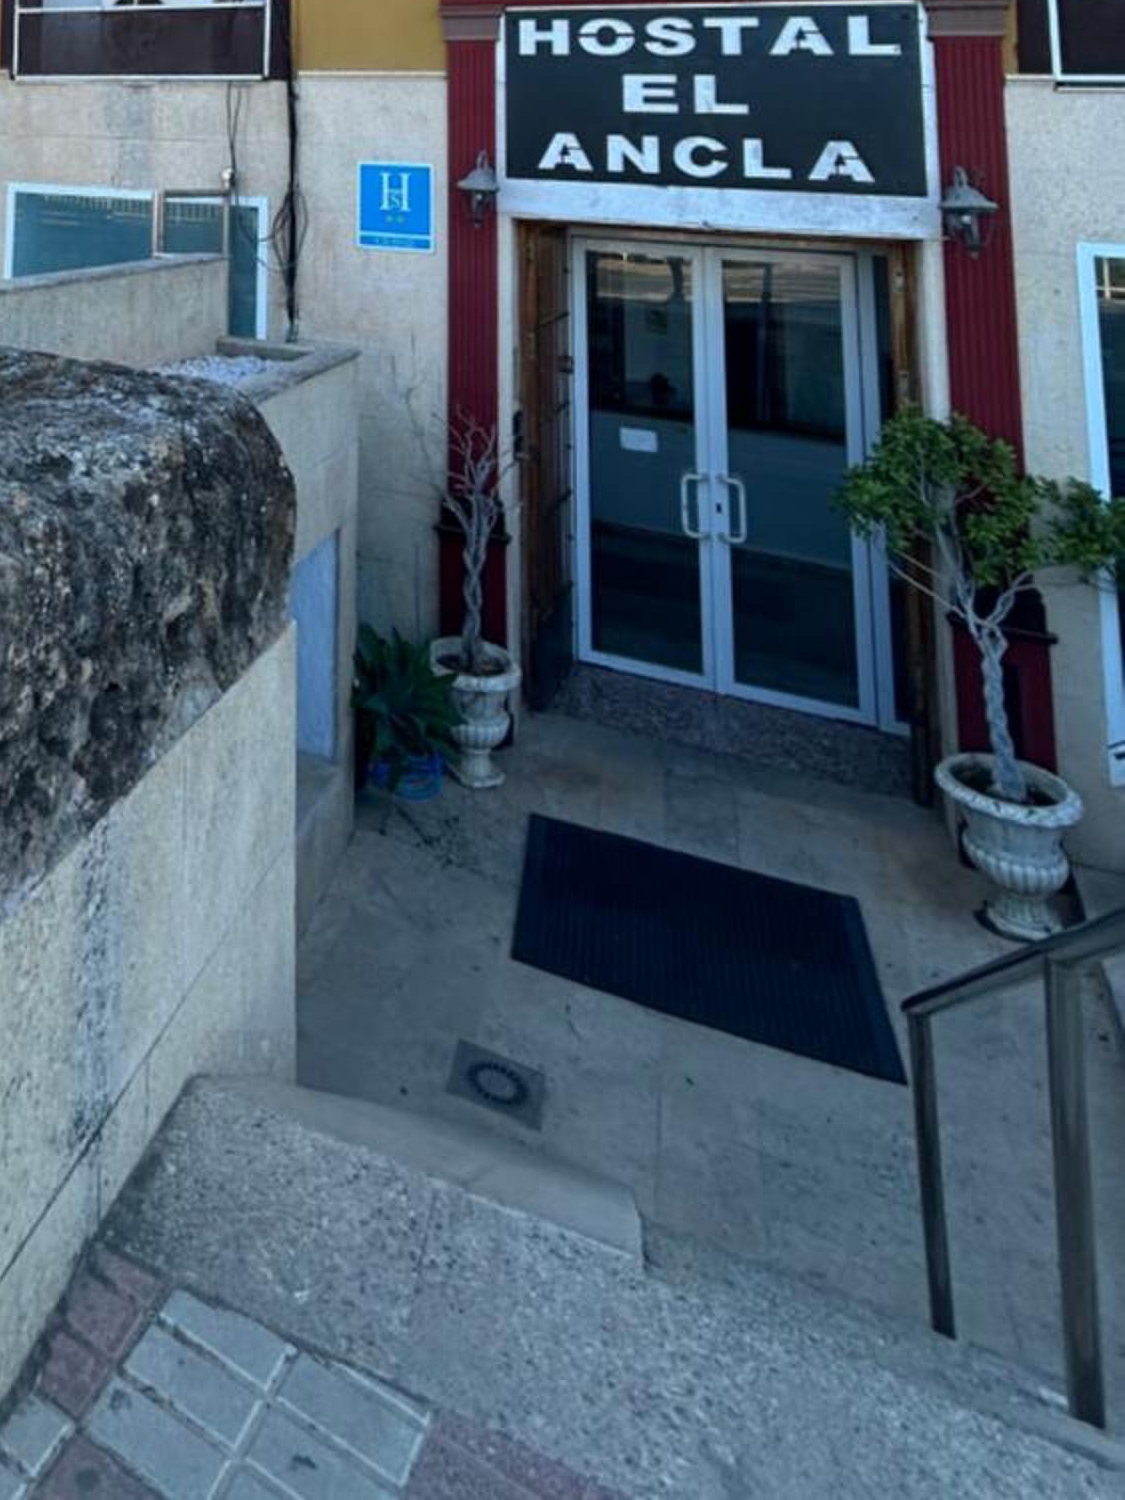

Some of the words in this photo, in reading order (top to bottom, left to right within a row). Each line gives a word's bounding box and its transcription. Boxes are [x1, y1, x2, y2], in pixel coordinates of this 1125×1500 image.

[517, 14, 903, 57] HOSTAL
[622, 73, 750, 116] EL
[537, 132, 877, 184] ANCLA
